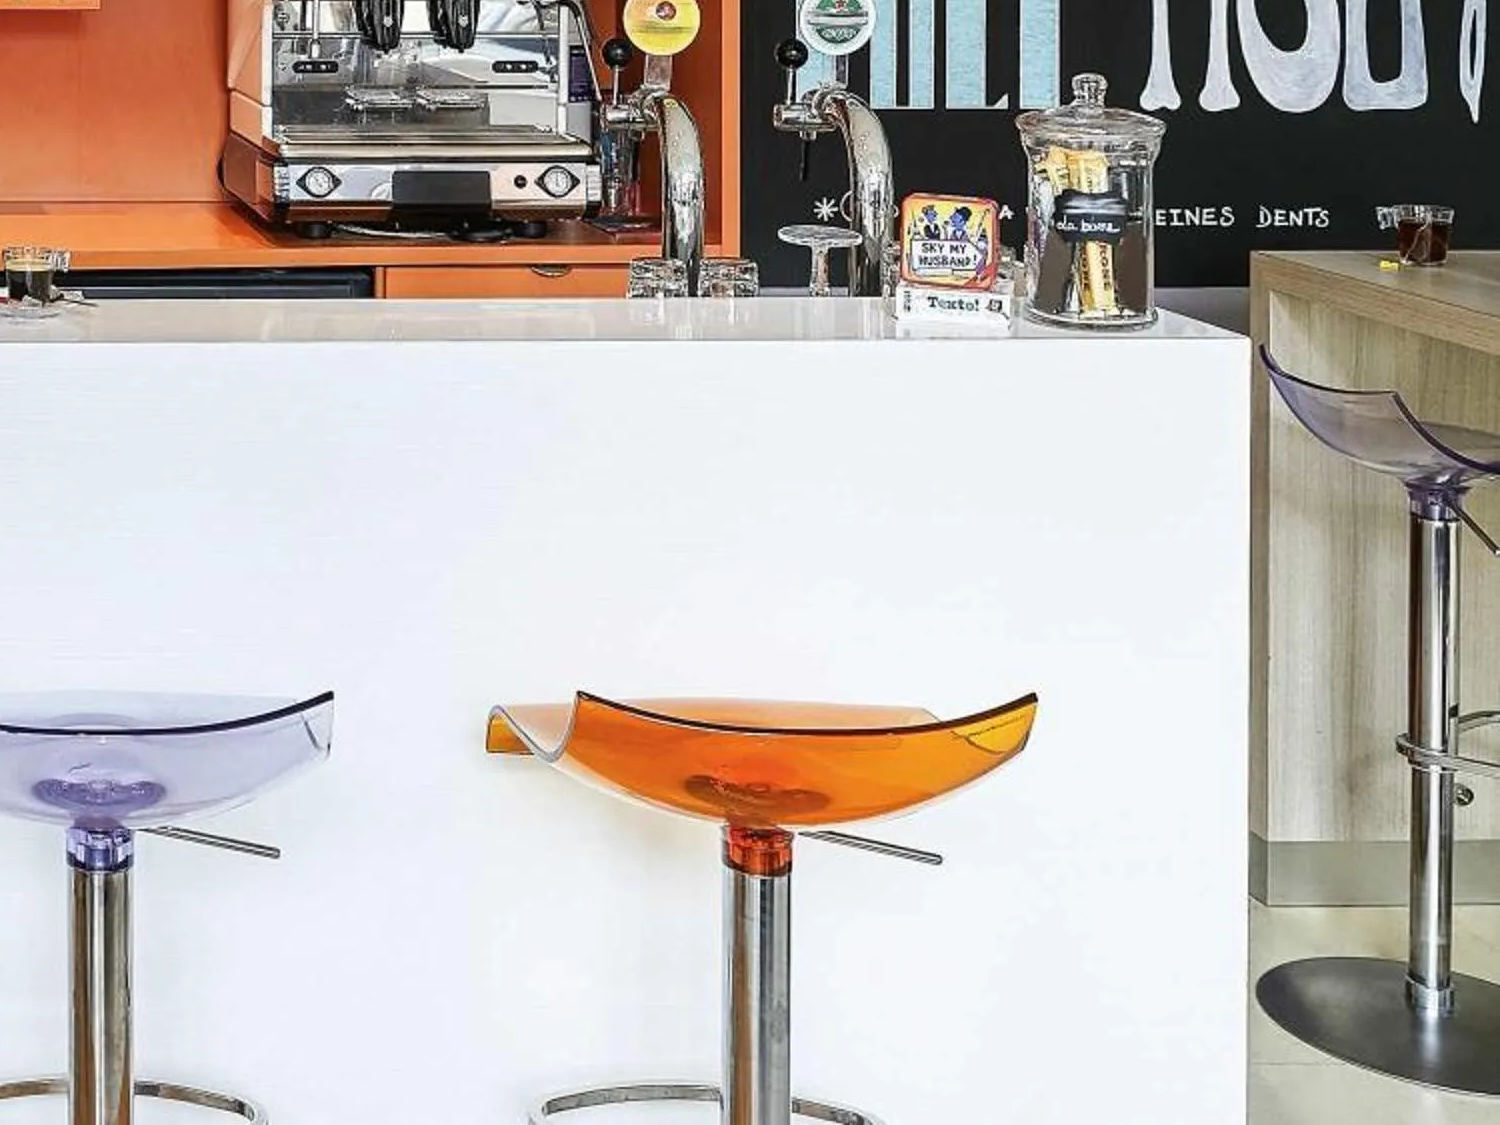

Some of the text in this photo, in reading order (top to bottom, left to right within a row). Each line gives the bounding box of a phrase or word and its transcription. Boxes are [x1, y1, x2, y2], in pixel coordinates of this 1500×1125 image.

[1155, 206, 1235, 227] EINES
[1256, 204, 1330, 228] DENTS
[921, 242, 967, 254] SKY MY
[918, 255, 977, 267] HUSBAND!
